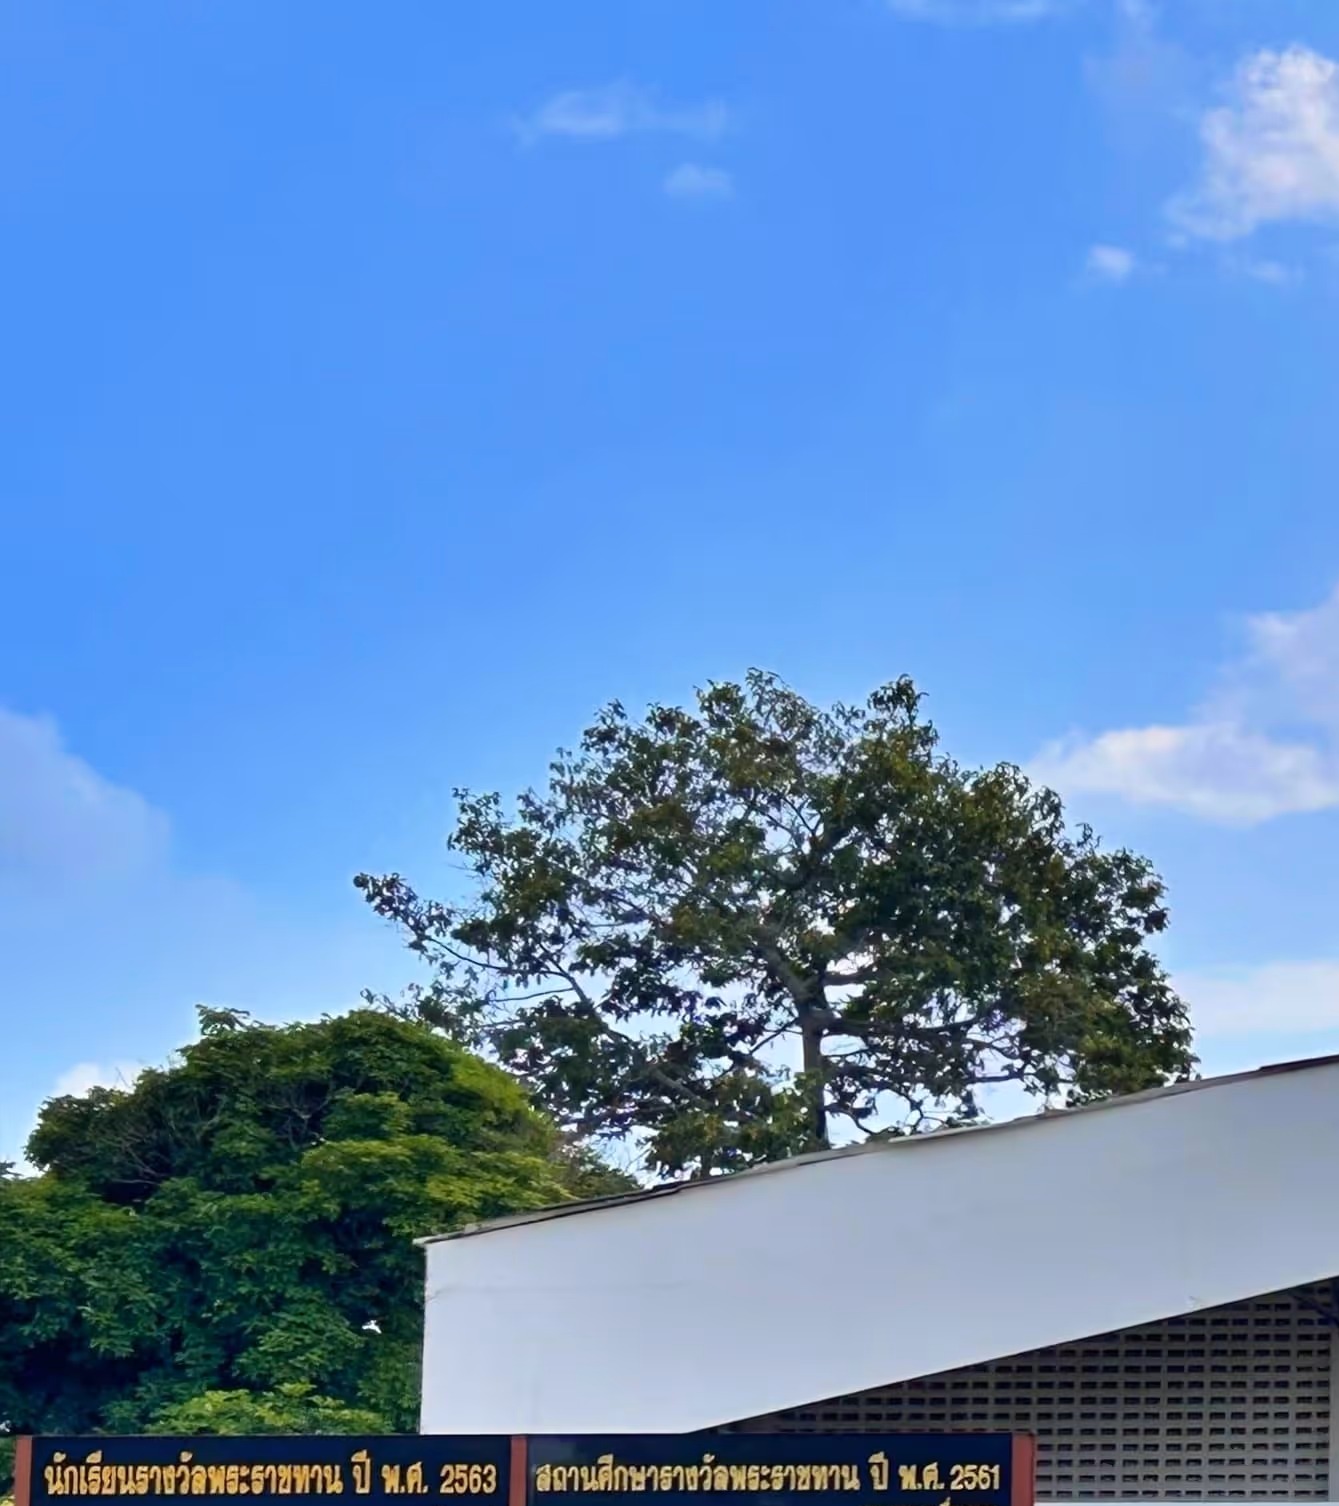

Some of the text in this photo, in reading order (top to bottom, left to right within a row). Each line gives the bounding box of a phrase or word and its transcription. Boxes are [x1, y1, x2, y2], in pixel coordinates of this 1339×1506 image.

[44, 1449, 497, 1496] นักเรียนรางวัลพระราชทาน ปี พ.ศ. 2563
[535, 1452, 1000, 1492] สถานศึกษารางวัลพระราชทาน ปี พ.ศ. 2561
